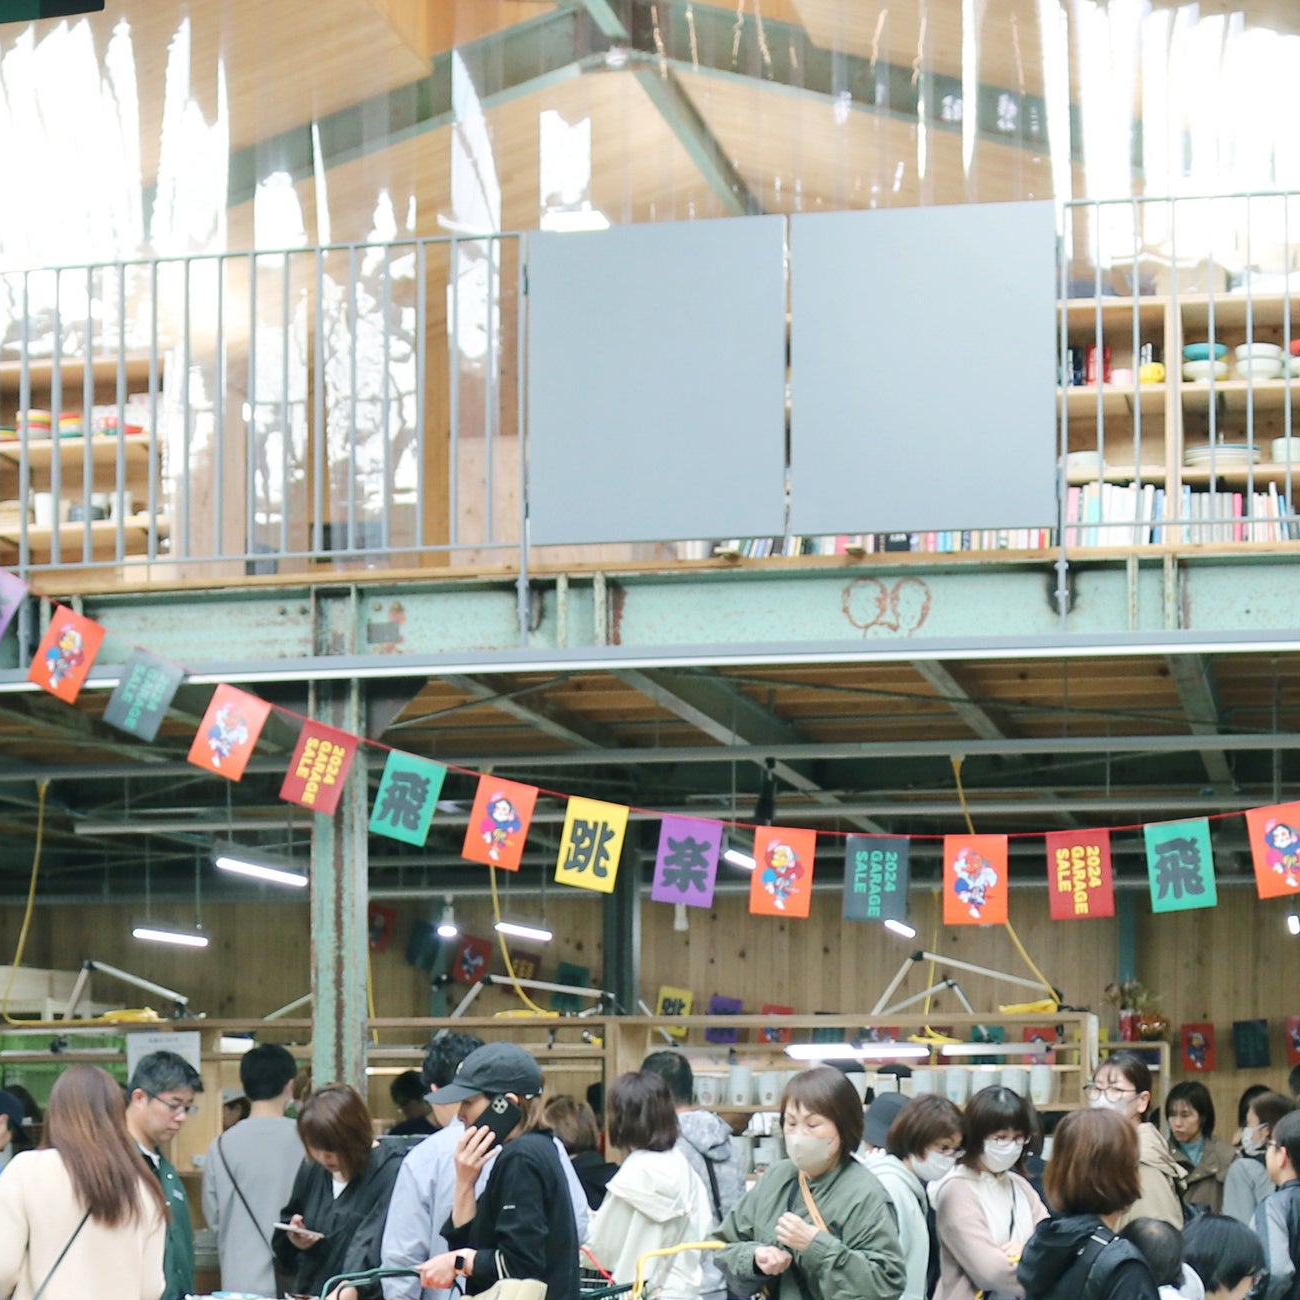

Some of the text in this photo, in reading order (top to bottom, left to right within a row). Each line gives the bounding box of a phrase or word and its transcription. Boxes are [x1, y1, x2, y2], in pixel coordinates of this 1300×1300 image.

[296, 736, 320, 779] SALE
[301, 740, 332, 805] GARAGE
[323, 745, 346, 785] 2024
[377, 771, 431, 831] 飛
[564, 819, 615, 878] 跳
[661, 836, 712, 893] 楽
[854, 850, 868, 893] SALE
[884, 851, 898, 892] 2024
[1056, 848, 1072, 892] SALE
[1086, 846, 1102, 889] 2024
[1154, 837, 1205, 900] 飛
[868, 850, 883, 917] GARAGE
[1071, 846, 1089, 915] GARAGE
